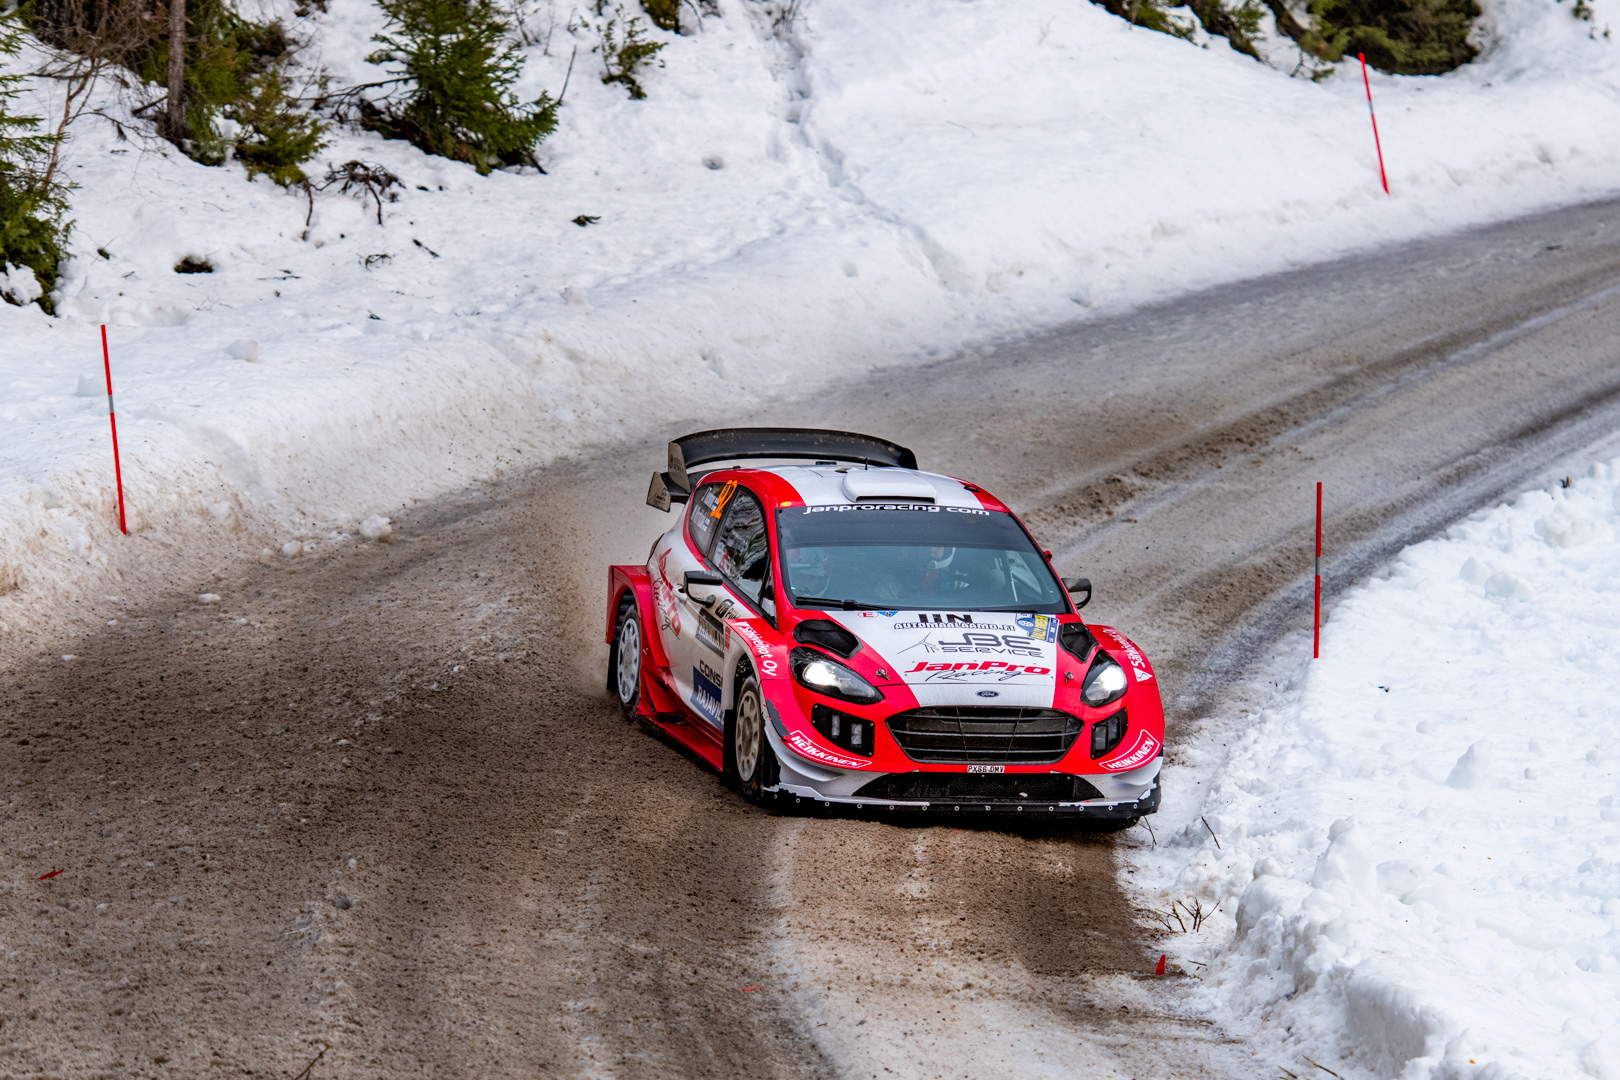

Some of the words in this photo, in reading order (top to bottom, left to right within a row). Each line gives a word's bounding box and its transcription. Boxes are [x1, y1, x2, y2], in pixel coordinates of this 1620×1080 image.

[941, 646, 1045, 658] SERVICE
[761, 660, 778, 676] Oy
[904, 660, 1051, 675] JanPro
[925, 669, 1051, 682] Racing
[790, 735, 863, 767] HEIKKINEN
[1106, 736, 1155, 769] HEIKKINEN
